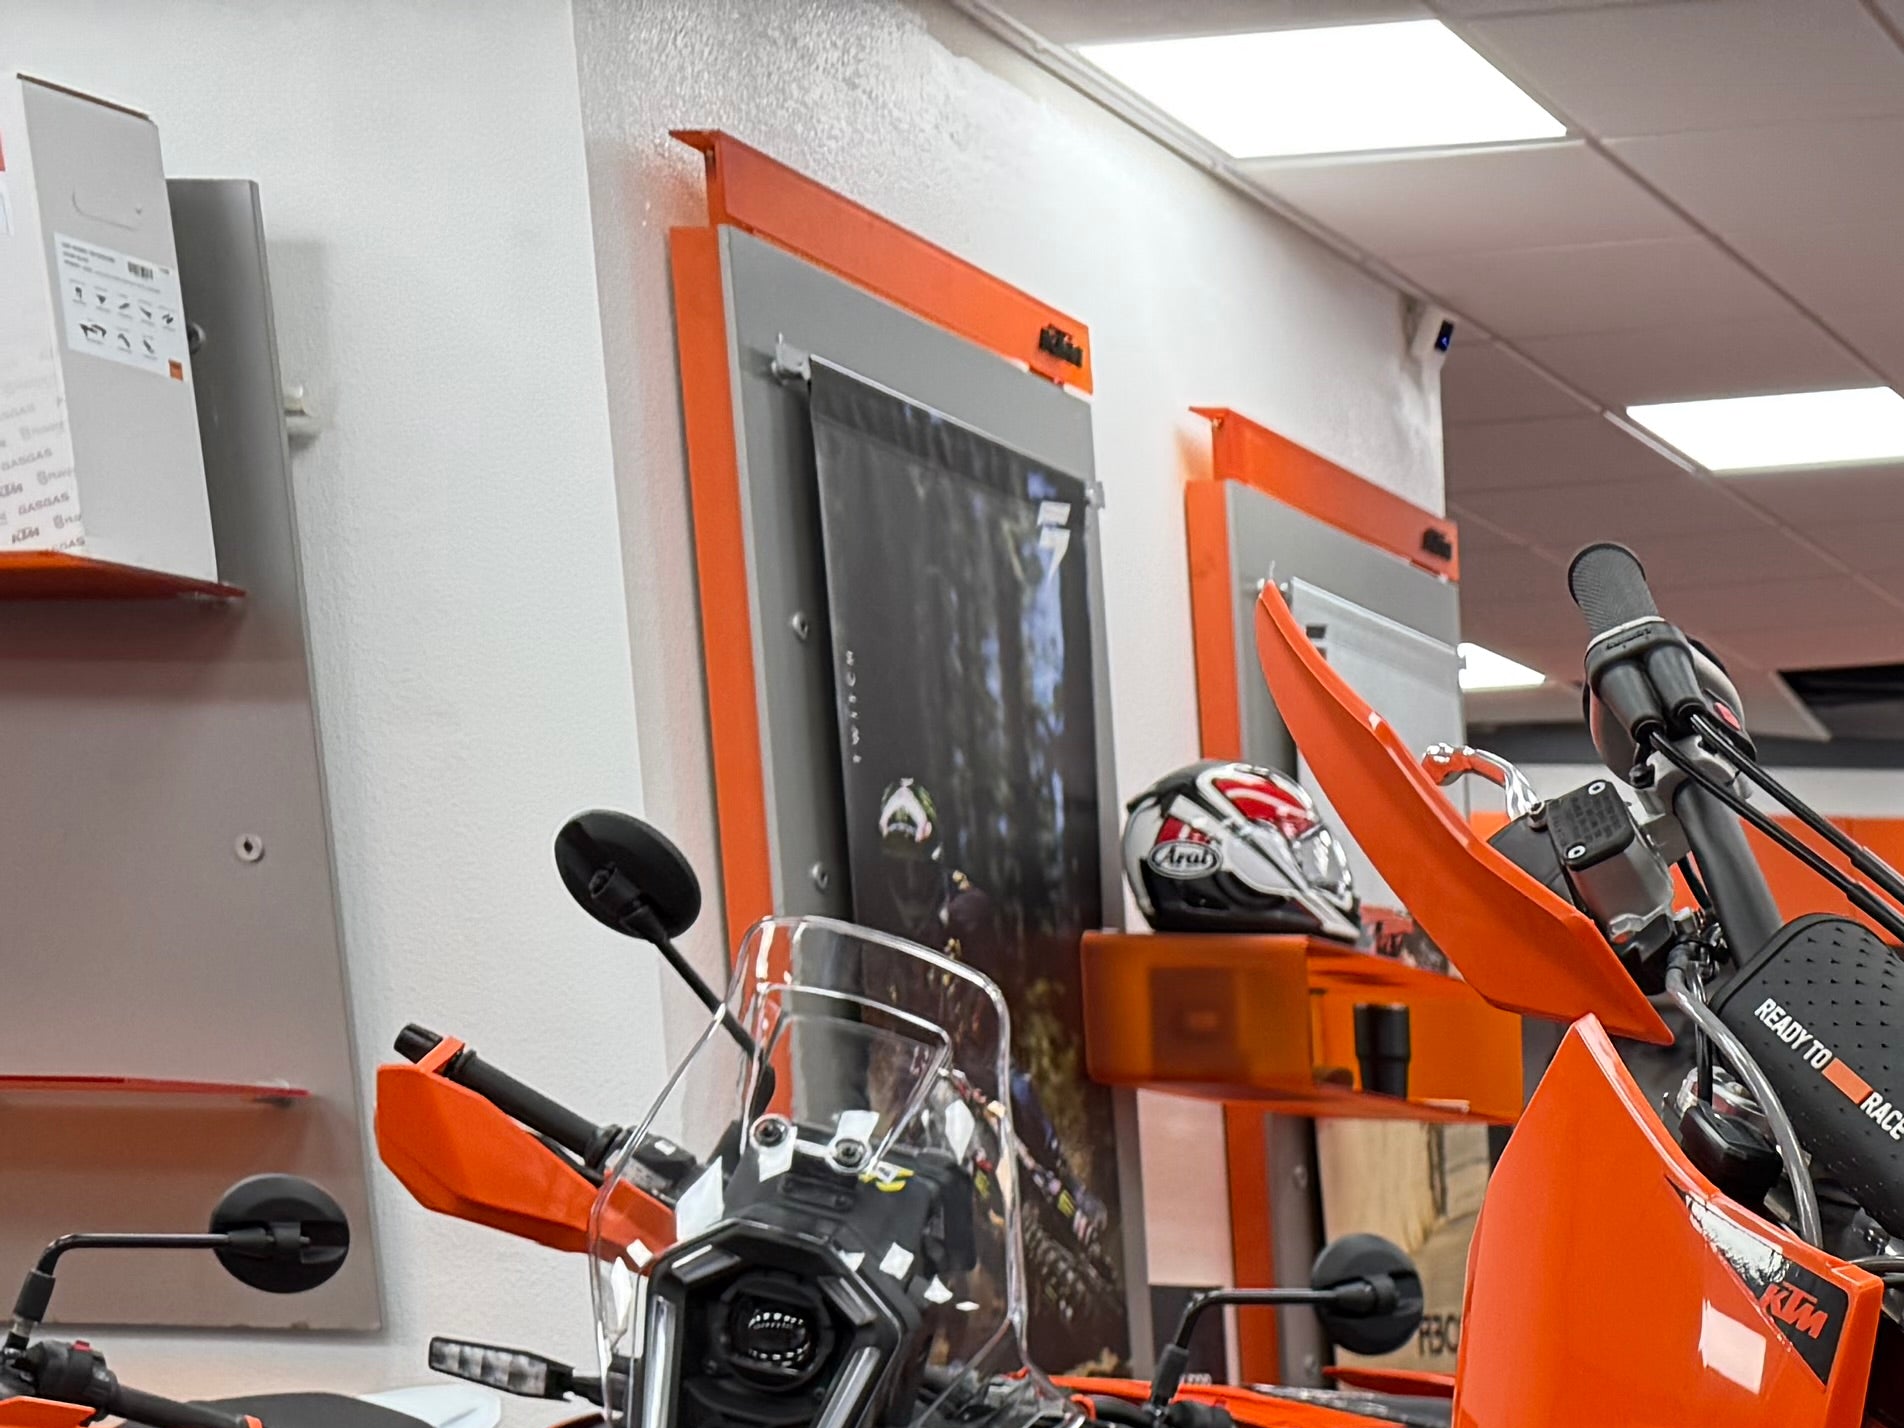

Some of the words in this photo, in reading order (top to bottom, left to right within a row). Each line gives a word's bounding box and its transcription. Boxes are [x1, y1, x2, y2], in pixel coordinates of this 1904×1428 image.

[18, 492, 70, 515] GASGAS
[11, 526, 40, 544] KTM
[1754, 998, 1814, 1050] READY
[1803, 1039, 1833, 1070] TO
[1759, 1280, 1829, 1339] KTM
